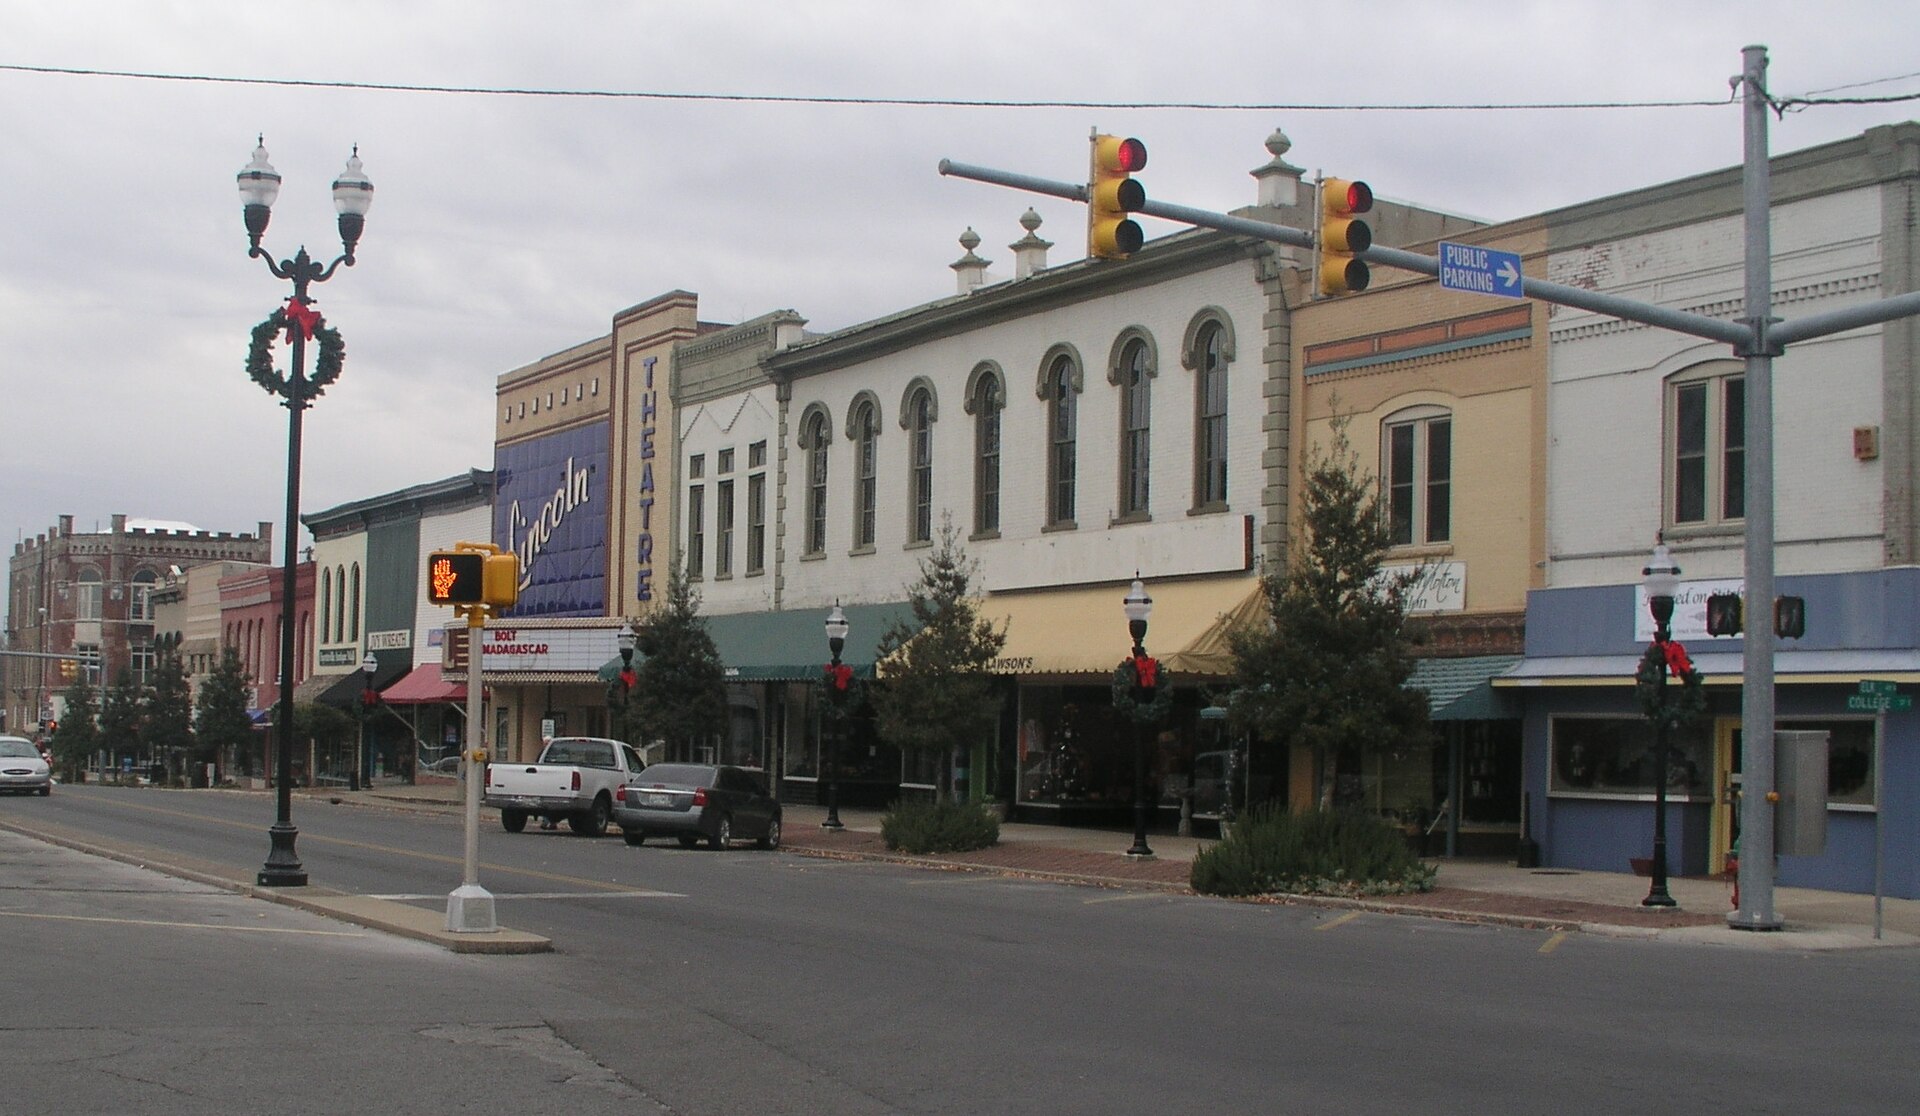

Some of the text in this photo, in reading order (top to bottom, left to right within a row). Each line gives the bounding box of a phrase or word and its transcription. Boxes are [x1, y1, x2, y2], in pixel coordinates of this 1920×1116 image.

[1446, 245, 1488, 270] PUBLIC
[1443, 267, 1493, 292] PARKING
[637, 356, 658, 601] THEATRE
[509, 456, 589, 592] Lincoln
[495, 630, 517, 641] BOLT
[482, 644, 548, 655] MADAGASCAR
[1848, 696, 1891, 709] COLLEGE
